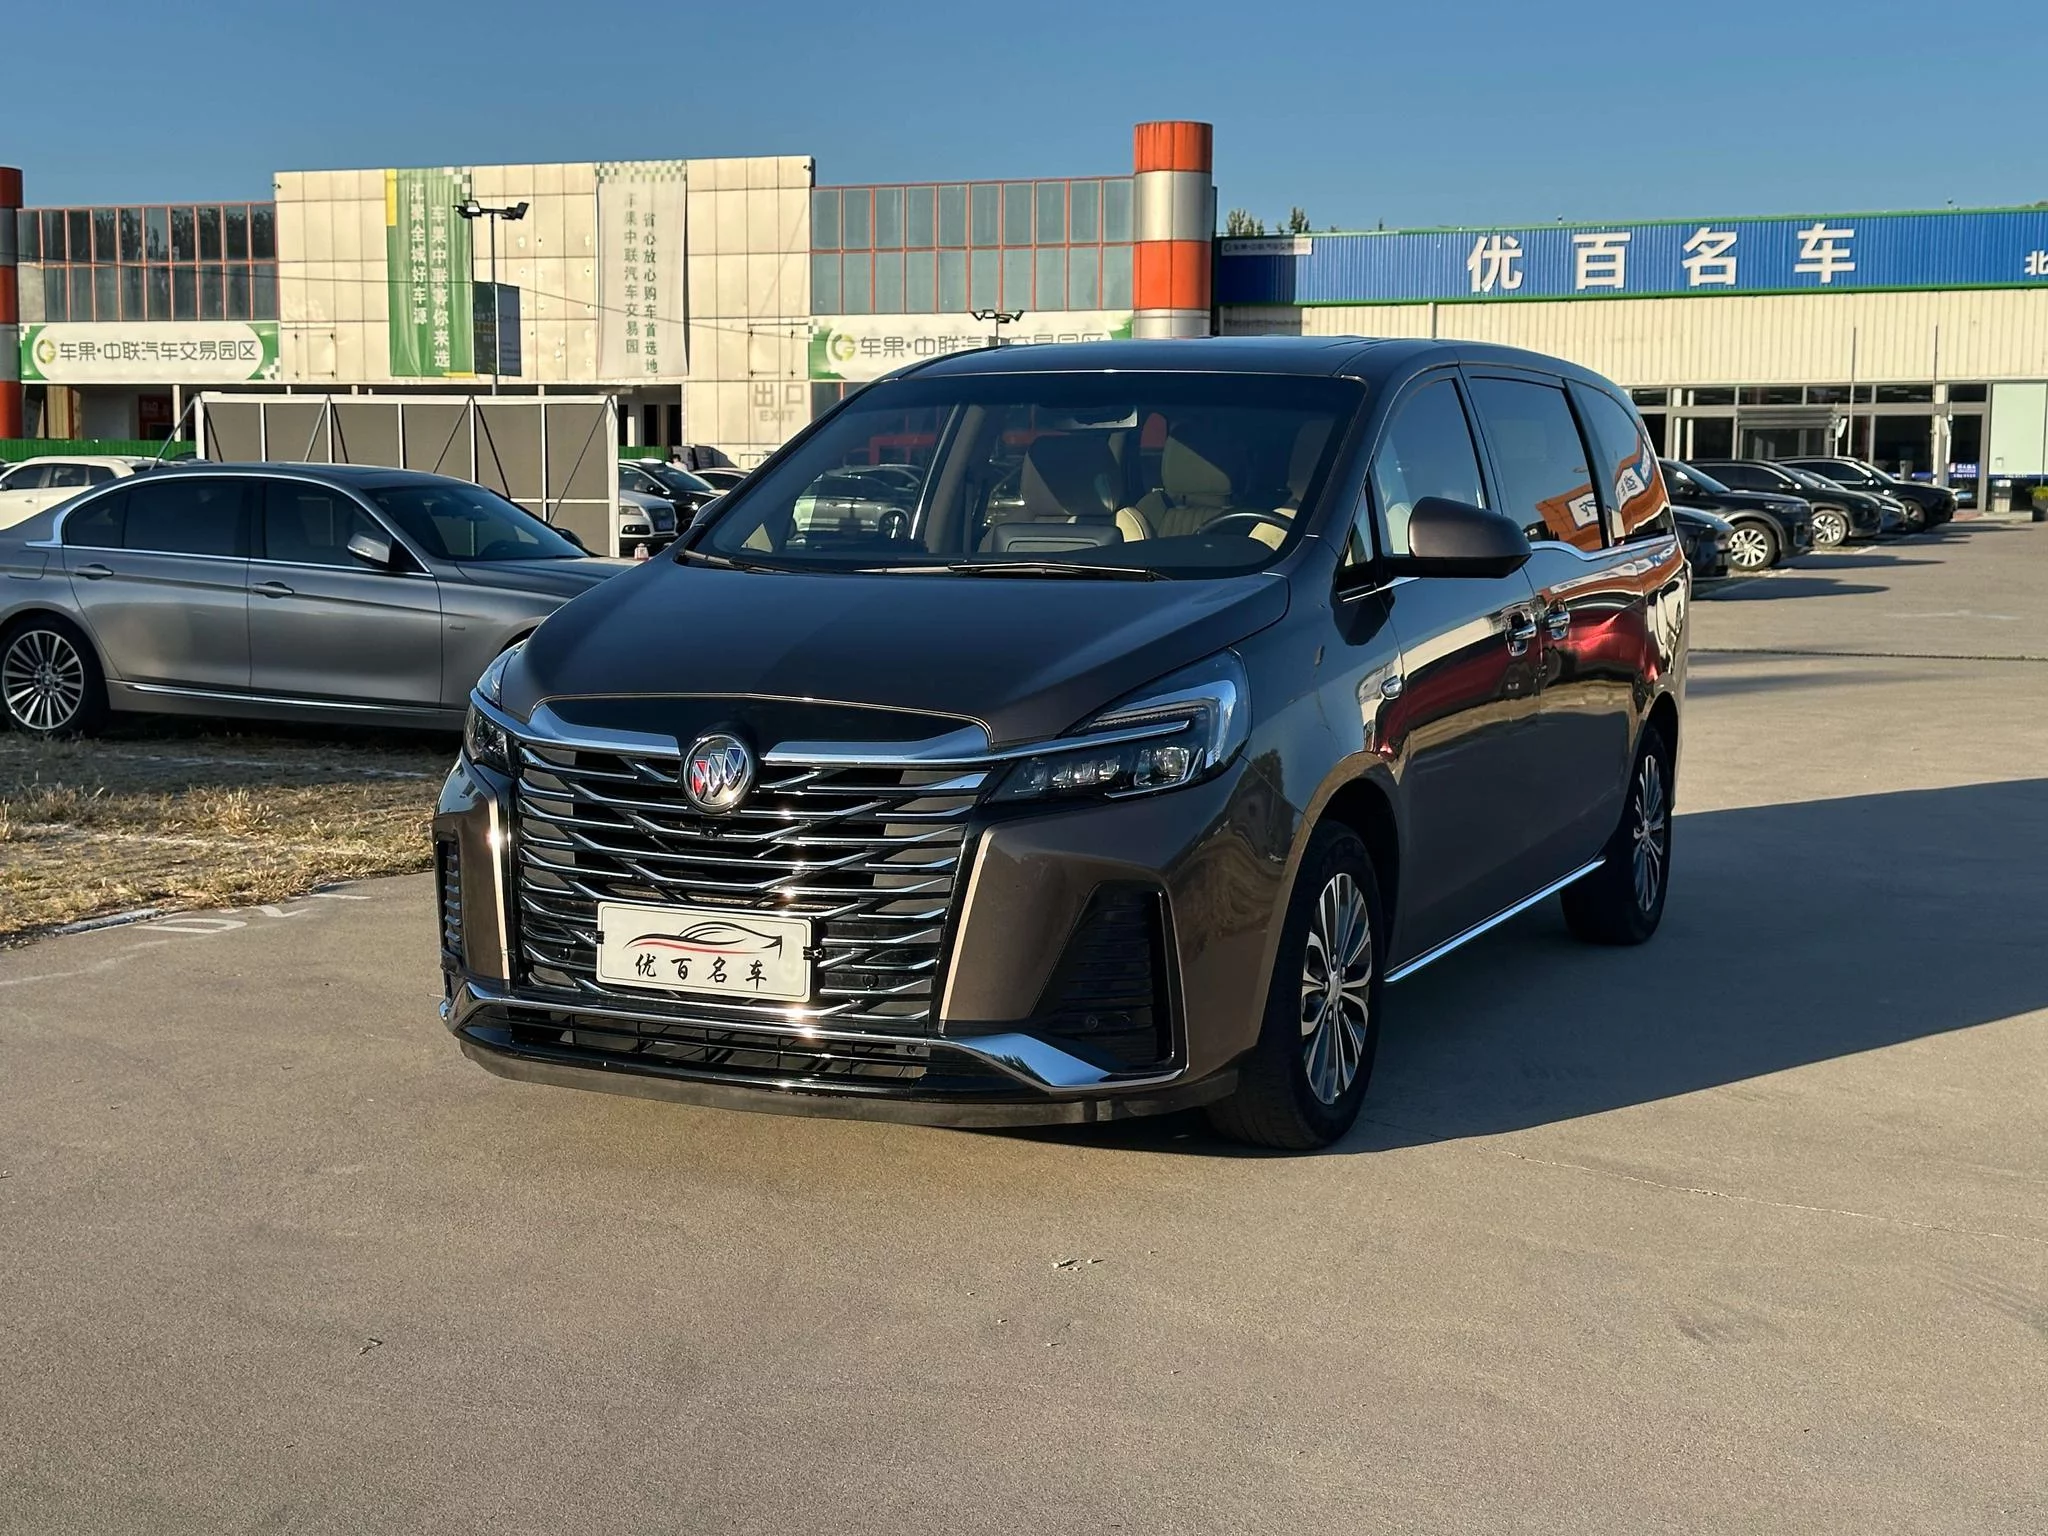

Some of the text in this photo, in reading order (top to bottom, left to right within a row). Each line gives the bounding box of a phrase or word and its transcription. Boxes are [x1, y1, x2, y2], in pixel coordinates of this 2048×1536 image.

[1467, 223, 1856, 293] 优百名车
[643, 213, 658, 373] 省心放心购车首选地
[60, 340, 258, 361] 车果·中联汽车交易园区
[754, 383, 804, 407] 出口
[759, 410, 795, 422] EXIT
[635, 953, 767, 991] 优百名车
